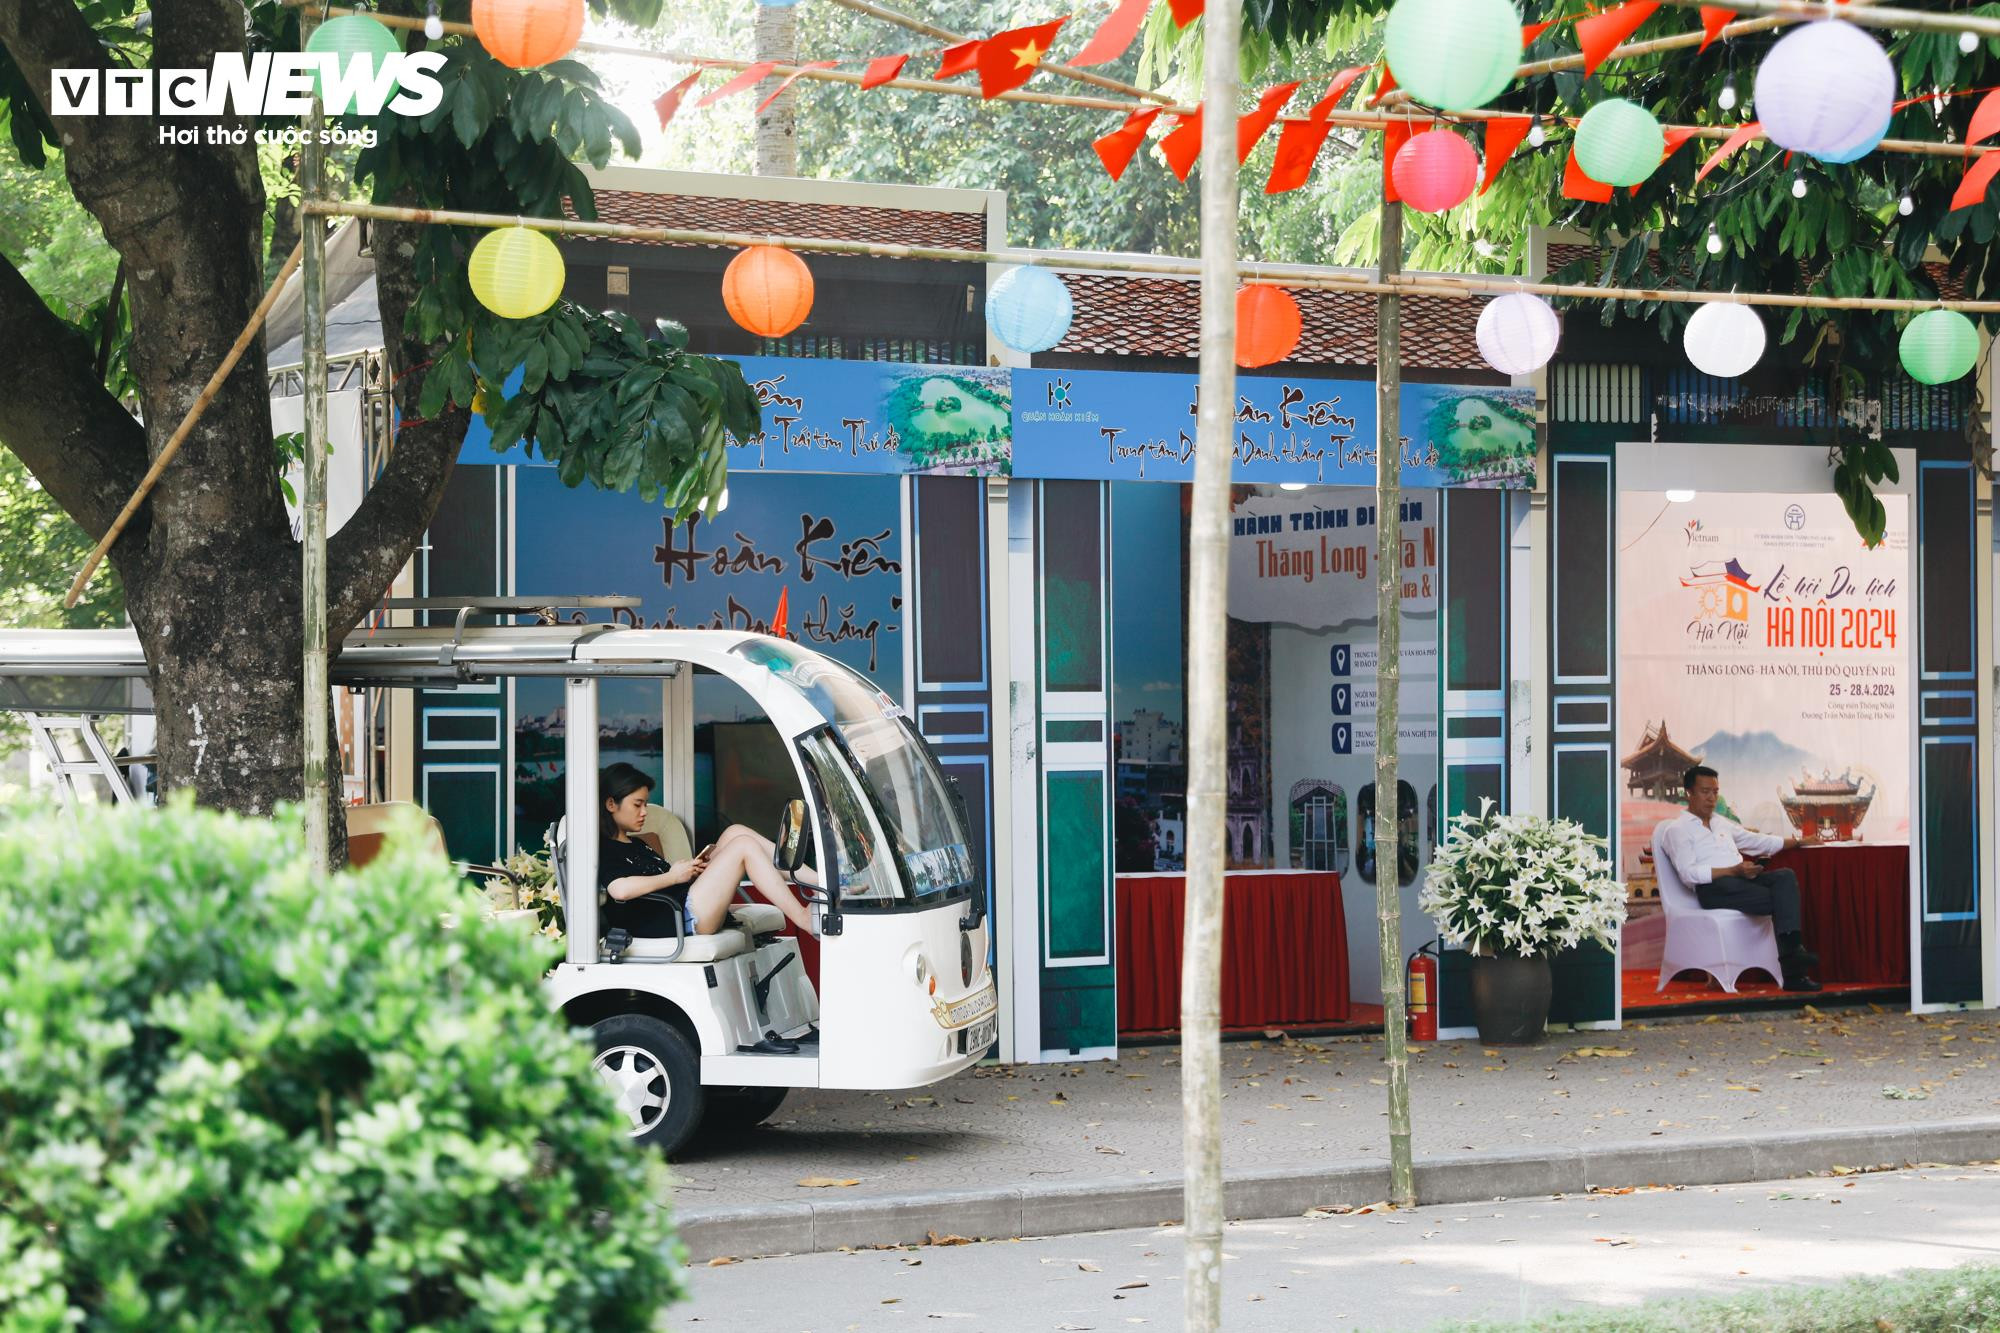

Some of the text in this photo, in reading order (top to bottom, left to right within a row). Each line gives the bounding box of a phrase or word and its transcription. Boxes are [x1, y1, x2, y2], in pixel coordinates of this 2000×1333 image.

[1280, 385, 1355, 431] Kiếm
[1101, 426, 1146, 478] Trung
[1148, 439, 1178, 461] tâm
[1241, 430, 1279, 467] Danh
[1282, 433, 1324, 482] thắng
[1234, 510, 1282, 536] HÀNH
[1290, 504, 1348, 532] TRÌNH
[1356, 506, 1375, 526] DI
[1684, 527, 1720, 546] Vietnam
[653, 511, 786, 589] Hoàn
[1321, 535, 1366, 579] Long
[1794, 576, 1821, 599] hội
[1825, 566, 1856, 599] Du
[1865, 577, 1896, 602] lịch
[803, 594, 881, 672] thắng
[1767, 596, 1896, 656] HÀ NỘI 2024
[1725, 664, 1754, 676] LONG
[1829, 684, 1841, 696] 25
[1850, 684, 1895, 696] 28.4.2024
